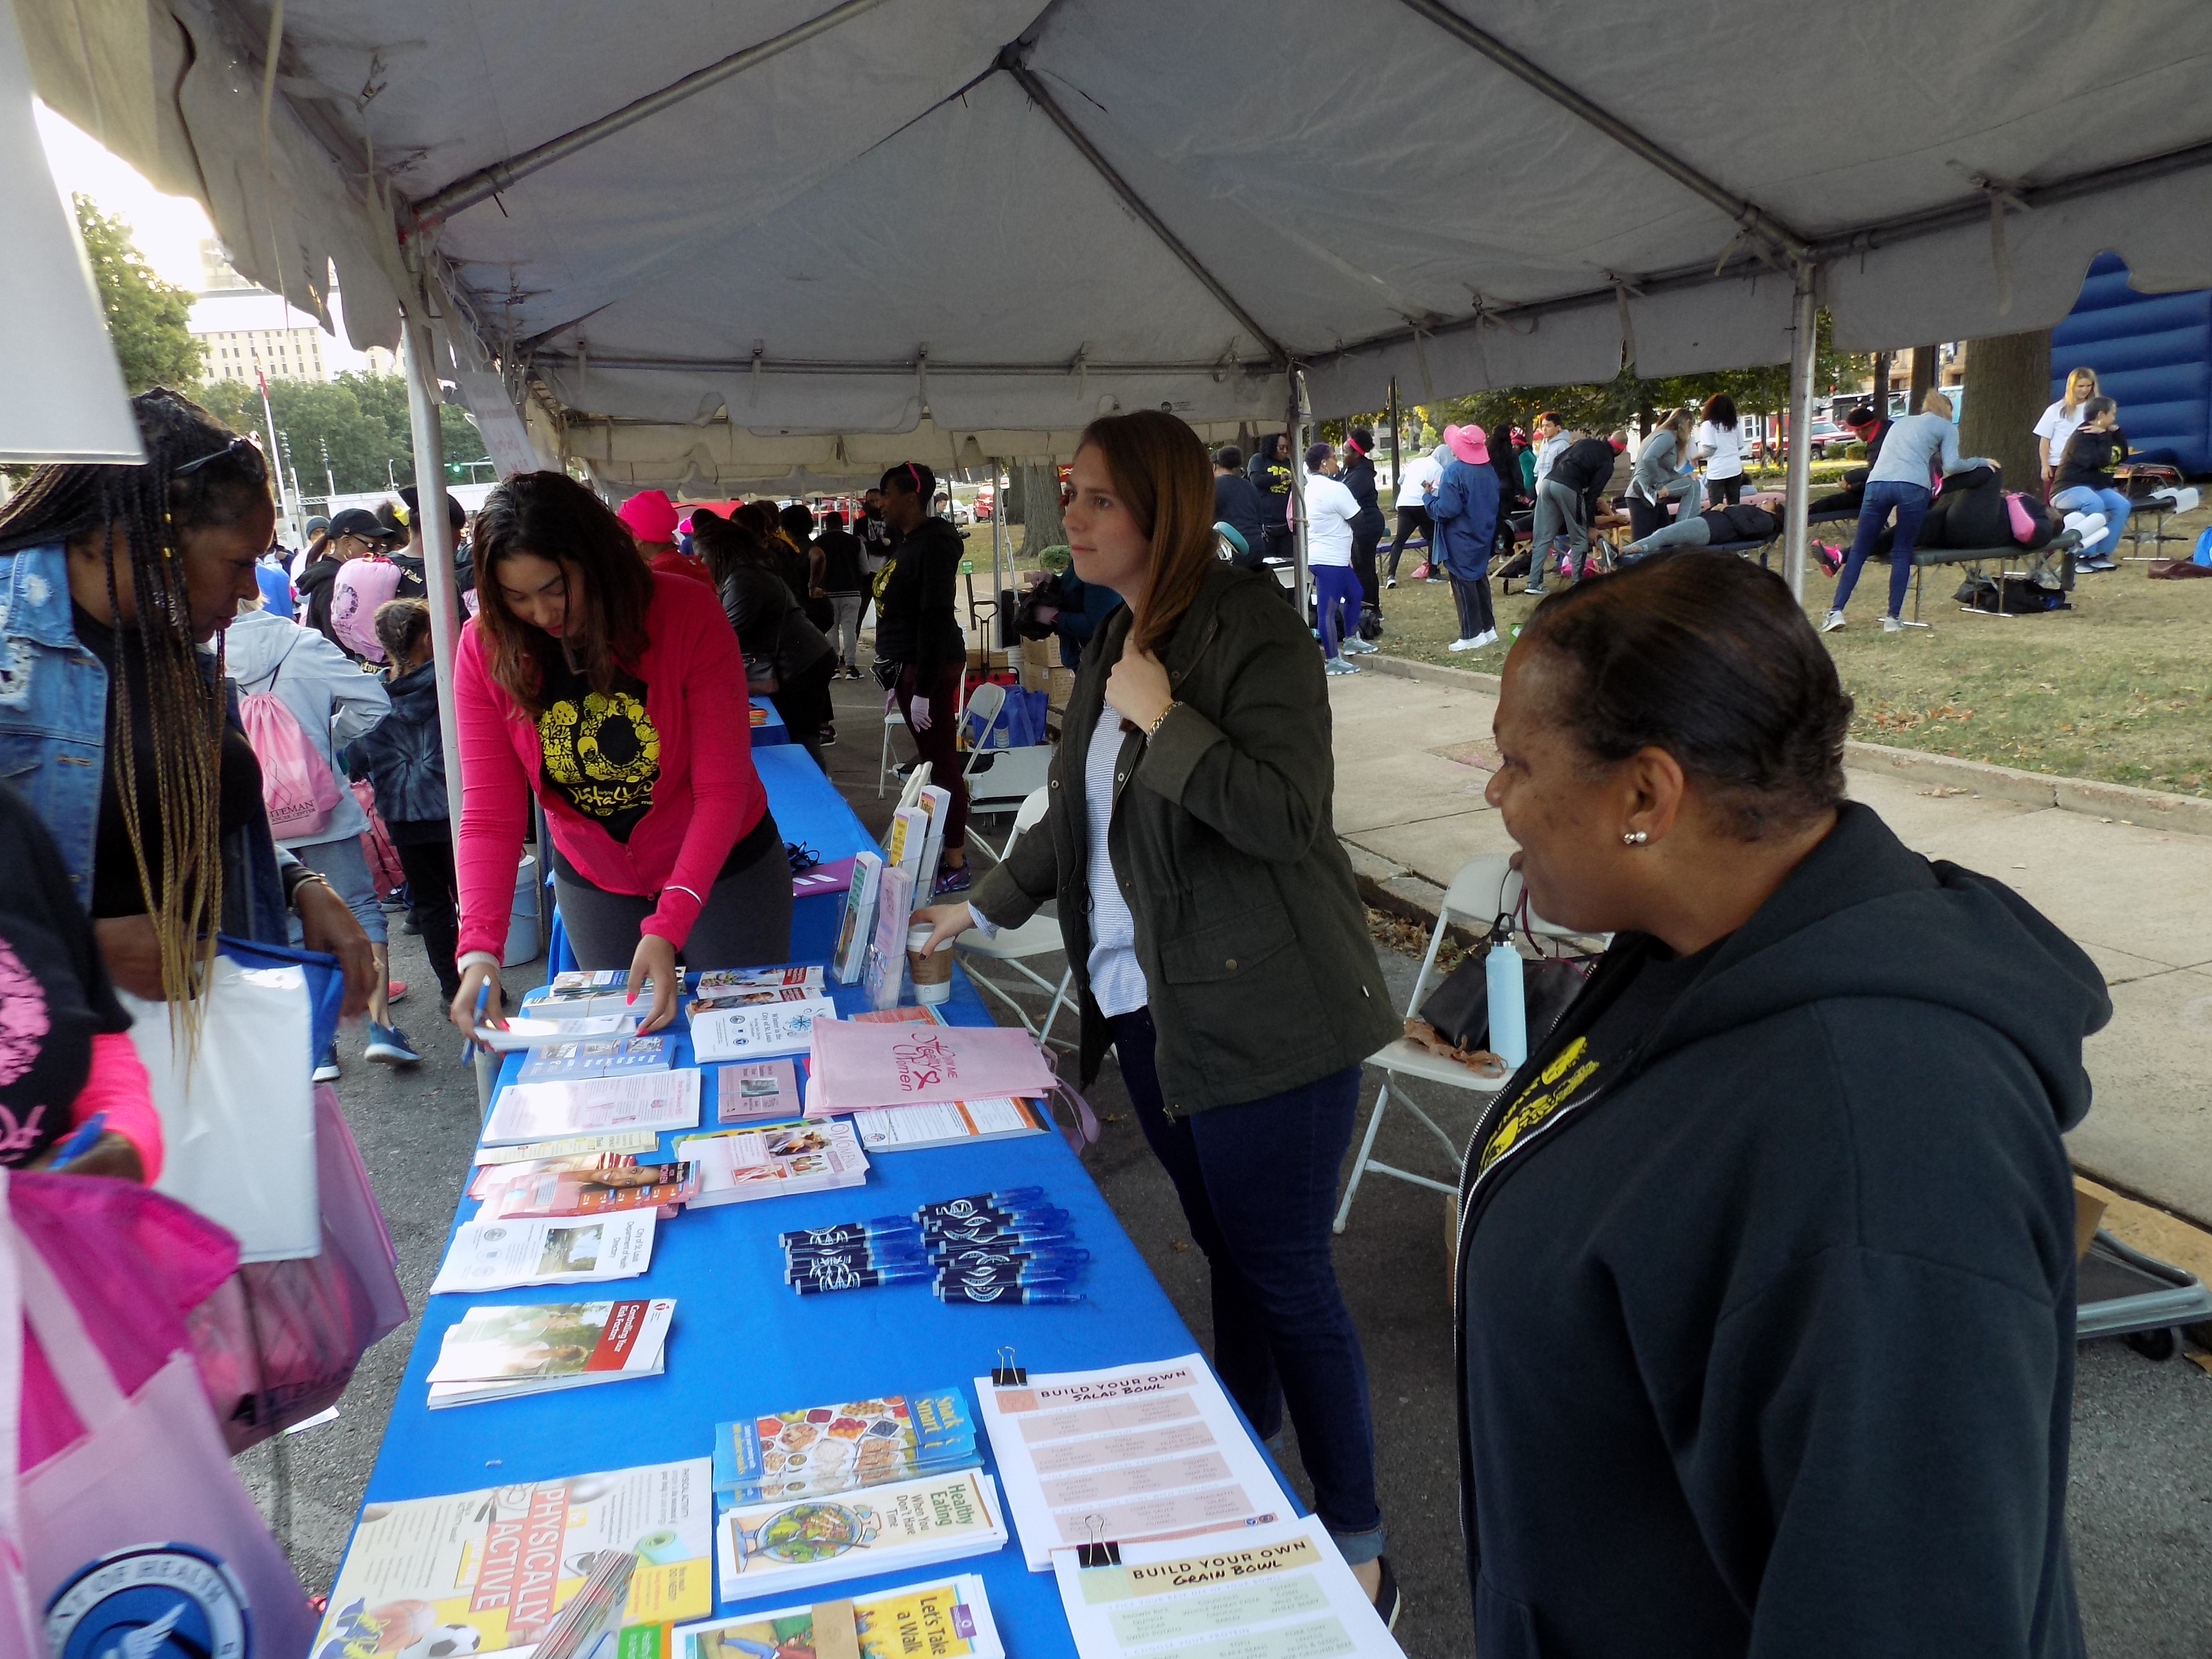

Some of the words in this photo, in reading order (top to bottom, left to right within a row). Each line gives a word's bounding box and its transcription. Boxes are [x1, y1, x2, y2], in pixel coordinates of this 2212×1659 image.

[404, 569, 423, 584] Fisher
[270, 799, 314, 817] ITEMAN
[271, 814, 292, 823] ANCER
[293, 808, 316, 817] CENTER
[659, 1164, 669, 1184] WOMEN
[621, 1221, 634, 1249] Department
[635, 1228, 645, 1237] City
[608, 1237, 621, 1258] Directory
[632, 1251, 641, 1262] Louis
[619, 1255, 629, 1269] Health
[1041, 1386, 1090, 1398] BUILD
[1097, 1378, 1140, 1390] YOUR
[1148, 1370, 1187, 1382] OWN
[1073, 1391, 1117, 1402] SALAD
[1122, 1383, 1165, 1395] BOWL
[915, 1399, 941, 1434] Smart
[935, 1395, 964, 1429] Snack
[681, 1468, 689, 1493] PHYSICAL
[680, 1495, 689, 1518] ACTIVITY
[896, 1495, 911, 1517] Don't
[911, 1494, 926, 1515] When
[929, 1491, 953, 1527] Eating
[948, 1483, 975, 1527] Healthy
[885, 1509, 899, 1528] Time
[902, 1517, 916, 1536] Have
[916, 1516, 930, 1531] You
[476, 1522, 521, 1609] ACTIVE
[515, 1488, 566, 1625] PHYSICALLY
[1133, 1563, 1192, 1580] BUILD
[1199, 1554, 1253, 1568] YOUR
[1261, 1541, 1307, 1559] OWN
[135, 1560, 225, 1606] HEALTH
[1173, 1571, 1226, 1586] GRAIN
[1231, 1559, 1283, 1574] BOWL
[919, 1595, 939, 1626] Let's
[899, 1621, 921, 1654] Walk
[927, 1628, 947, 1656] Take
